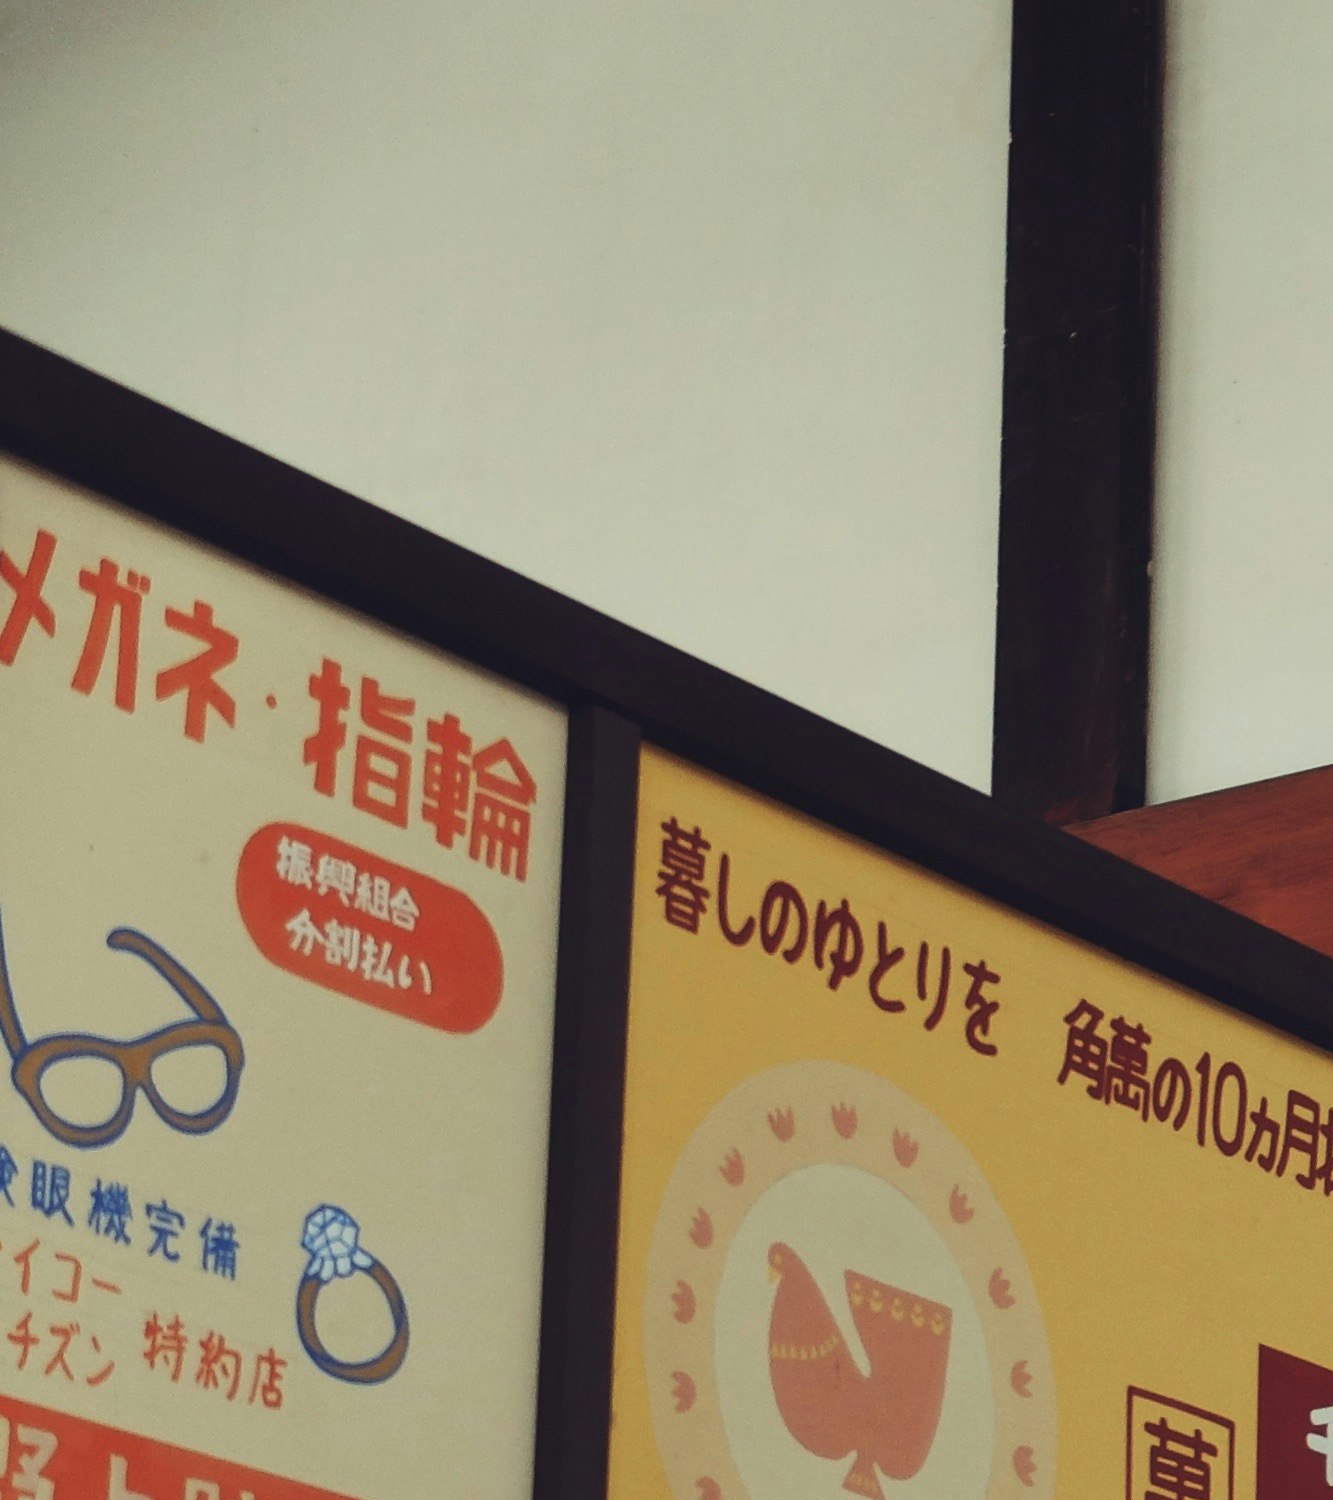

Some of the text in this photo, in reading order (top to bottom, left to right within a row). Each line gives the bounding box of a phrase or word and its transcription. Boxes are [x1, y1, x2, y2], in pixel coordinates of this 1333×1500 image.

[286, 908, 432, 995] 分割払い
[656, 816, 1000, 1056] 暮しのゆとりを
[0, 1239, 122, 1303] イコー
[143, 1312, 287, 1409] 特約店
